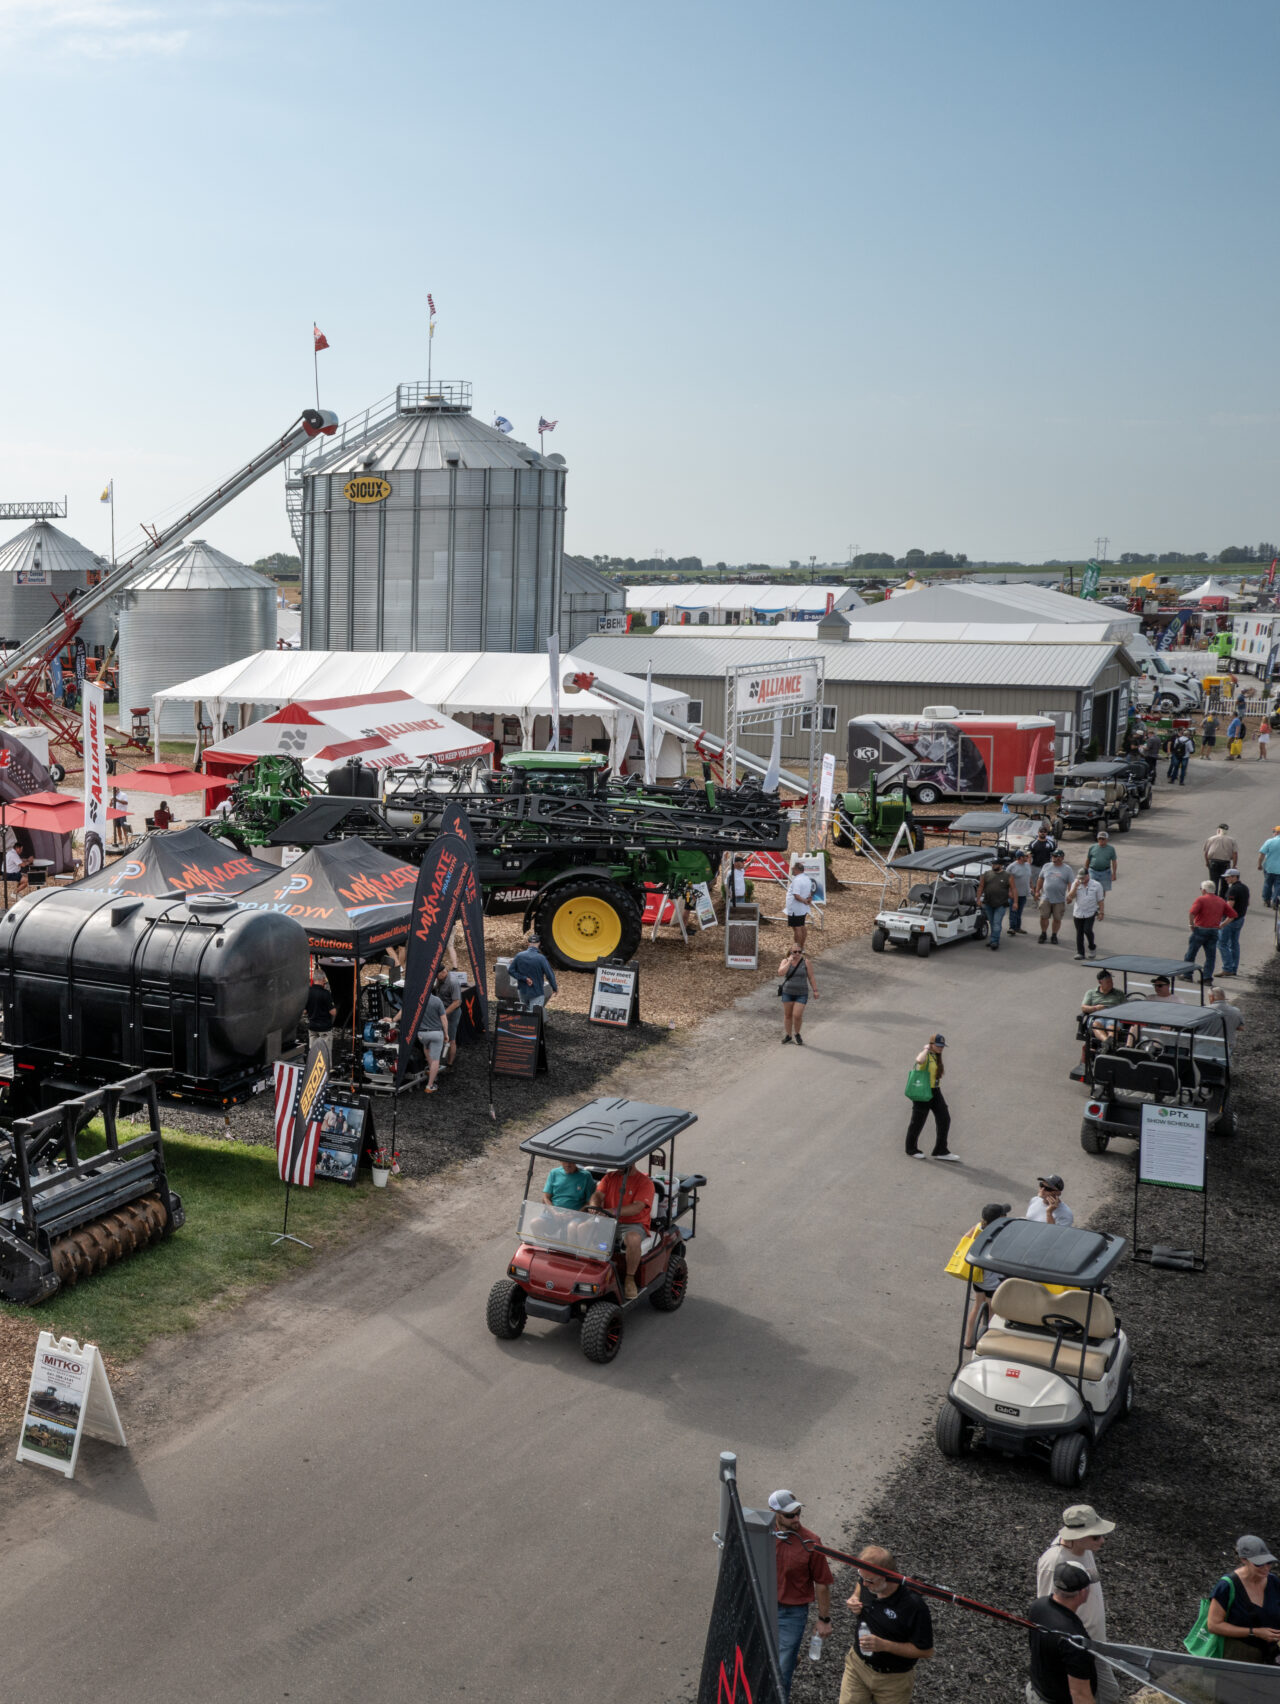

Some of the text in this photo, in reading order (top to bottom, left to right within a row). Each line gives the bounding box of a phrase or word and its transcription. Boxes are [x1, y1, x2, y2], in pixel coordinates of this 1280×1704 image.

[350, 482, 383, 498] SIOUX
[606, 617, 626, 629] BEHL
[758, 675, 802, 704] ALLIANCE
[375, 718, 445, 741] ALLIANCE
[89, 700, 102, 805] ALLIANCE
[445, 751, 457, 760] KEEP
[458, 749, 467, 758] YOU
[504, 889, 540, 902] ALLIAN
[308, 937, 353, 950] Solutions
[601, 969, 615, 977] Now
[301, 1051, 326, 1117] BRON
[1169, 1110, 1189, 1118] PTx
[1167, 1120, 1200, 1128] SCHEDULE
[44, 1355, 81, 1373] MITKO
